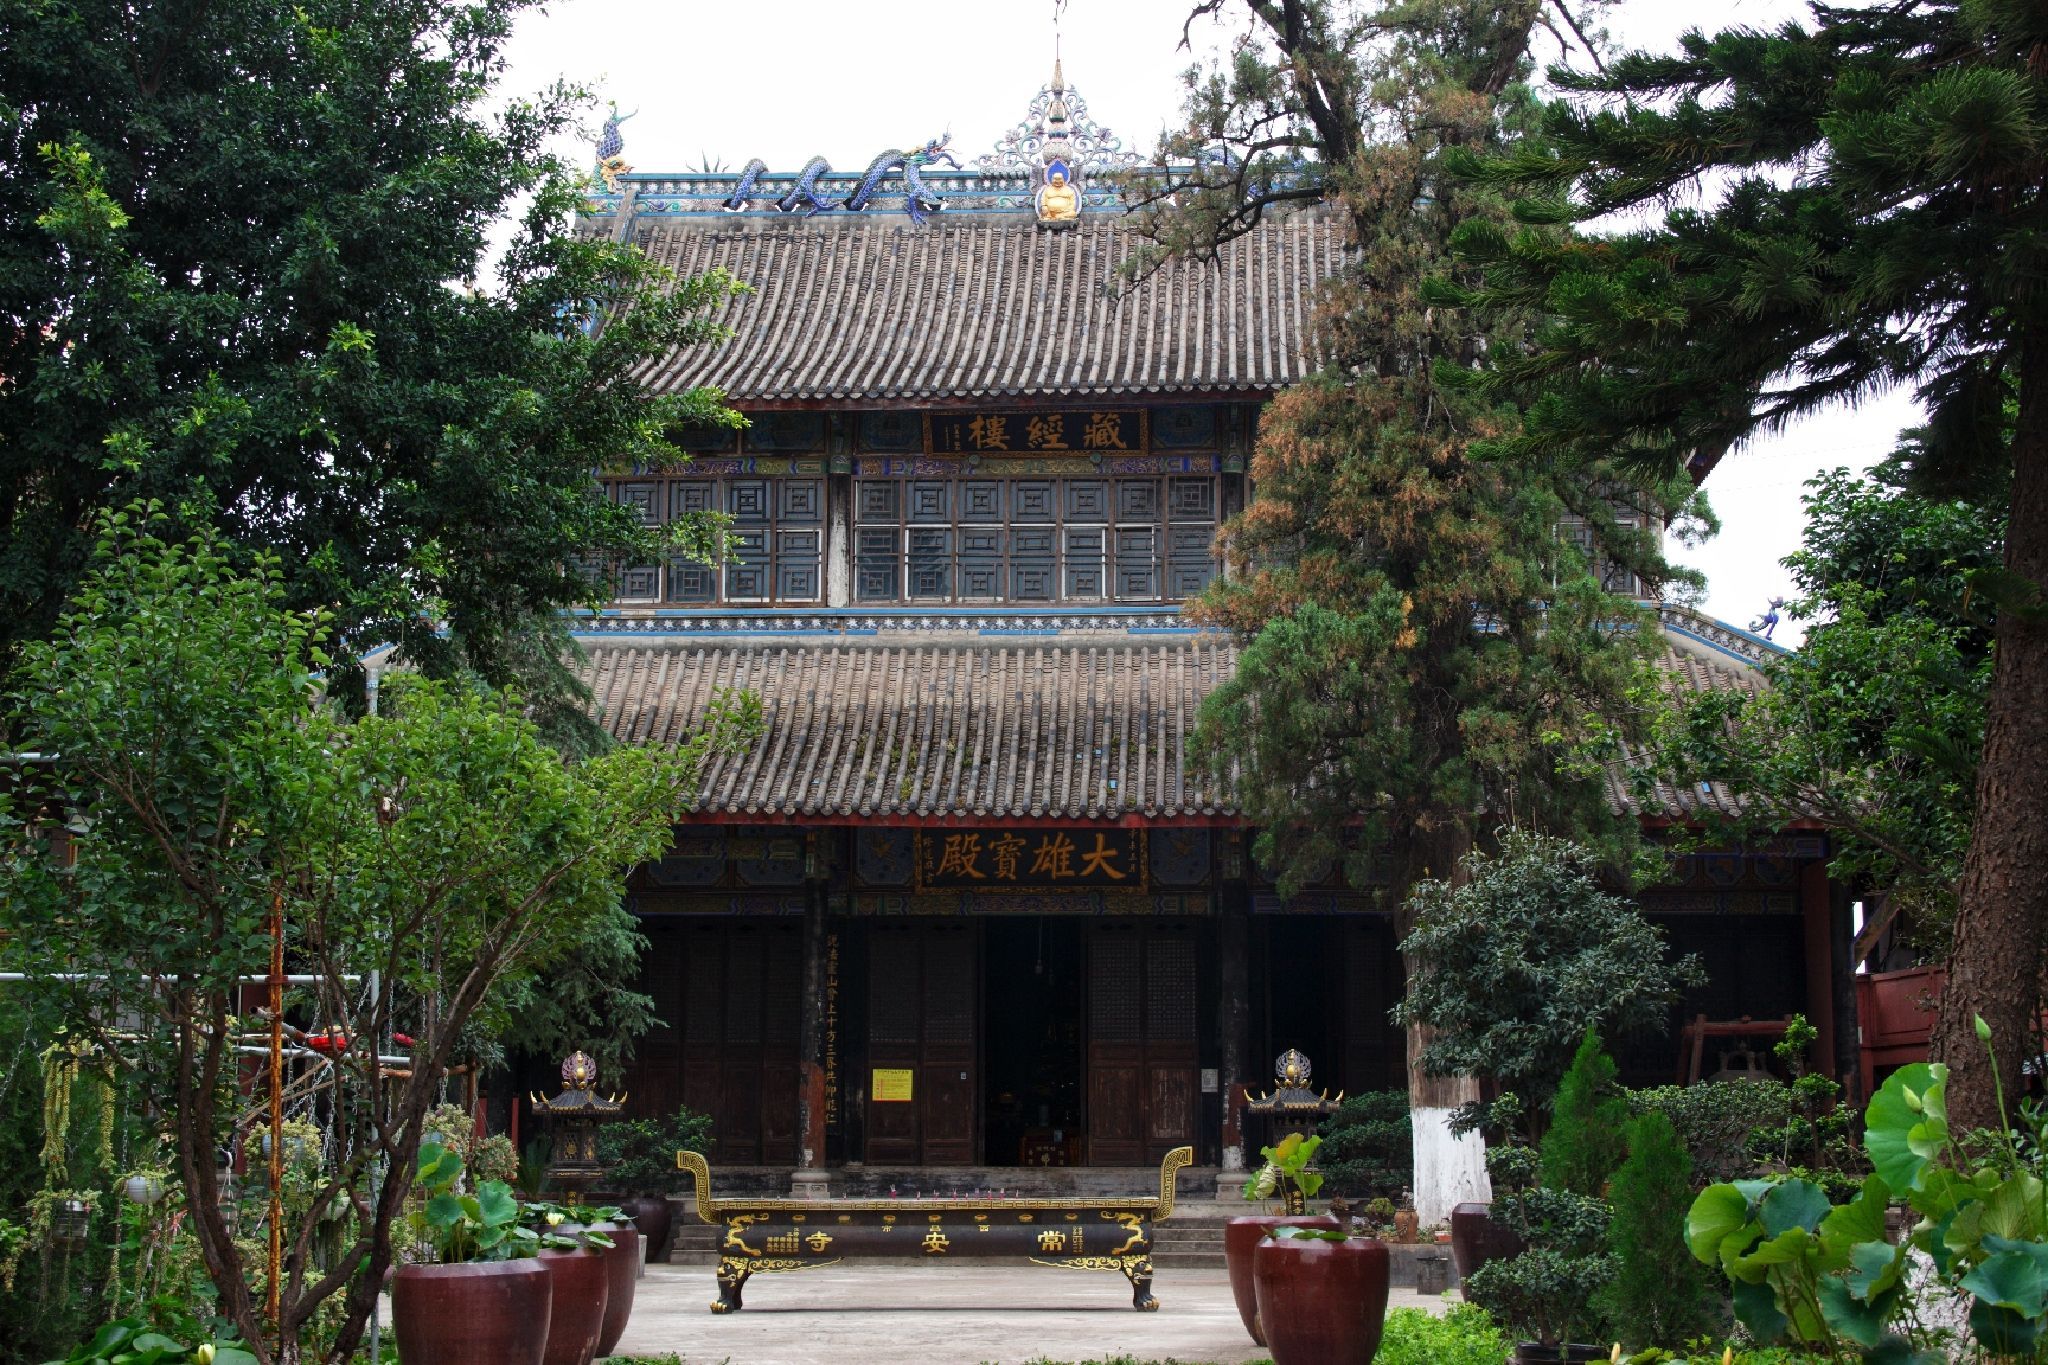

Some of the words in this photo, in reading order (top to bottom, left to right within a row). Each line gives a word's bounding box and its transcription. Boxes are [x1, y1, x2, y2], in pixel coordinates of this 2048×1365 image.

[968, 412, 1128, 450] 藏經樓
[935, 831, 1128, 880] 大雄寶殿
